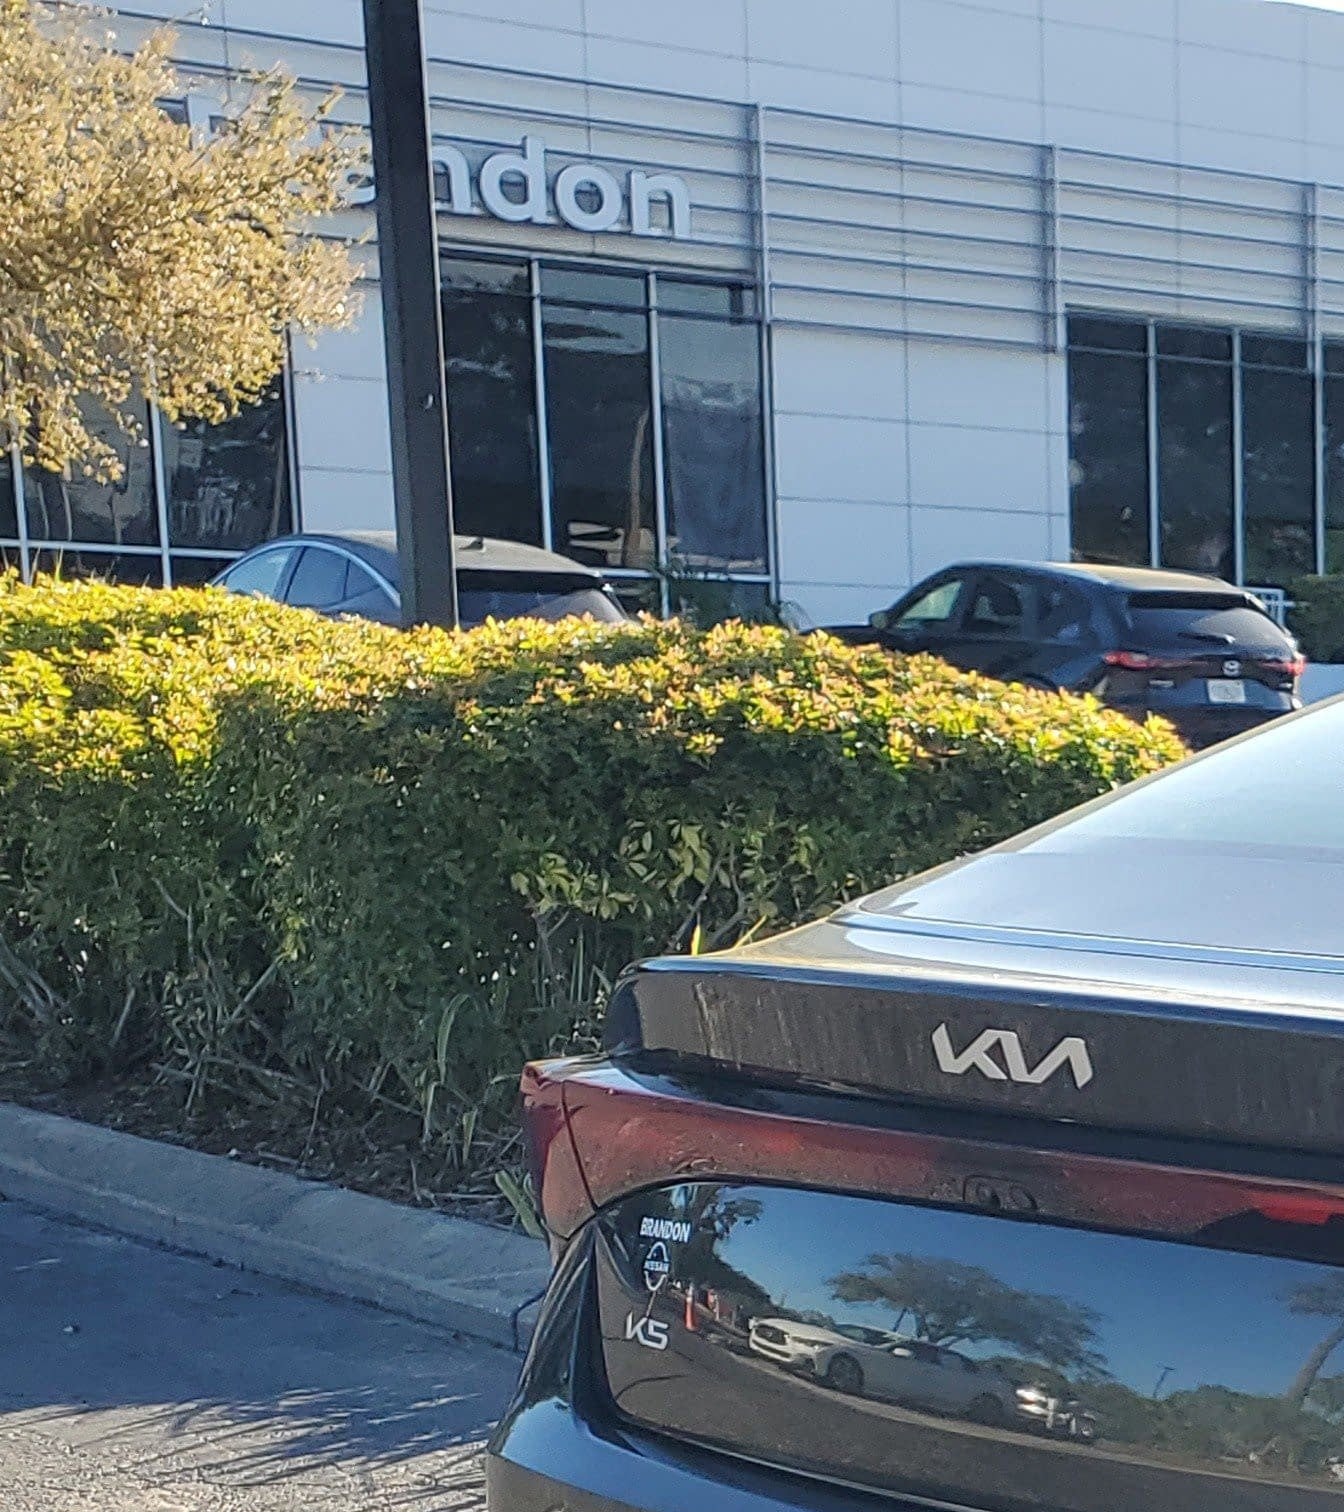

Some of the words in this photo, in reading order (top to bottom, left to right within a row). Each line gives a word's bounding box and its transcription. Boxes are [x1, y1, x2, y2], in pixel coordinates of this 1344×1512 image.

[345, 135, 692, 238] ndon
[931, 1022, 1094, 1090] KIA
[639, 1216, 691, 1243] BRANDON
[626, 1311, 669, 1350] K5
